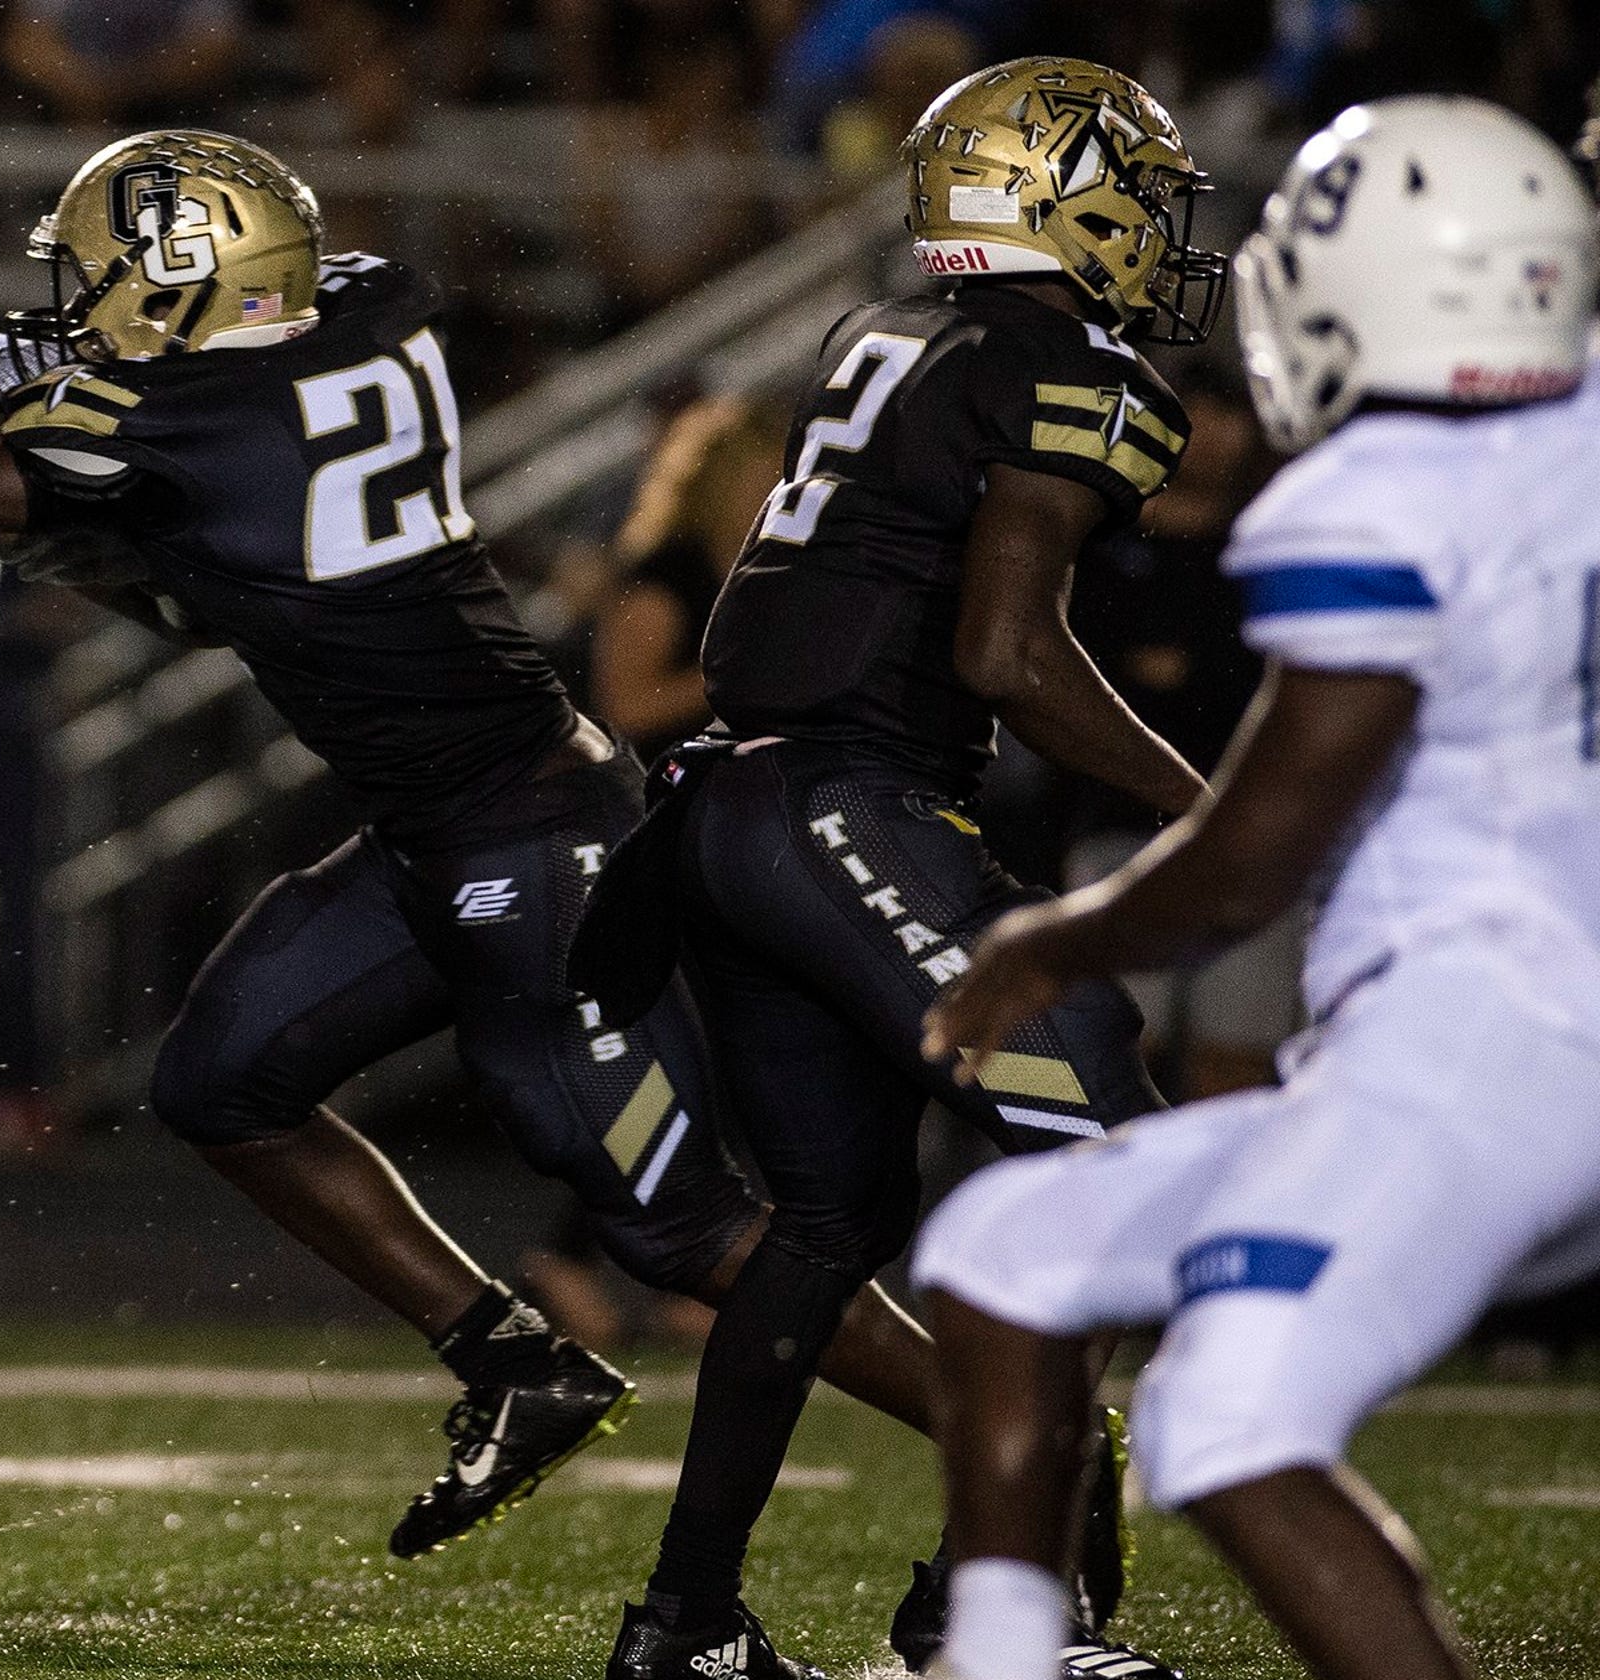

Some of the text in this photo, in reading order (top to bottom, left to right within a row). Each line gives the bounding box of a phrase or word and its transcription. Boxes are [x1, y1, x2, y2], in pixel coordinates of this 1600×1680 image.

[919, 247, 991, 275] ddell
[293, 326, 475, 583] 21
[758, 331, 928, 547] 2
[809, 809, 973, 986] TITAN
